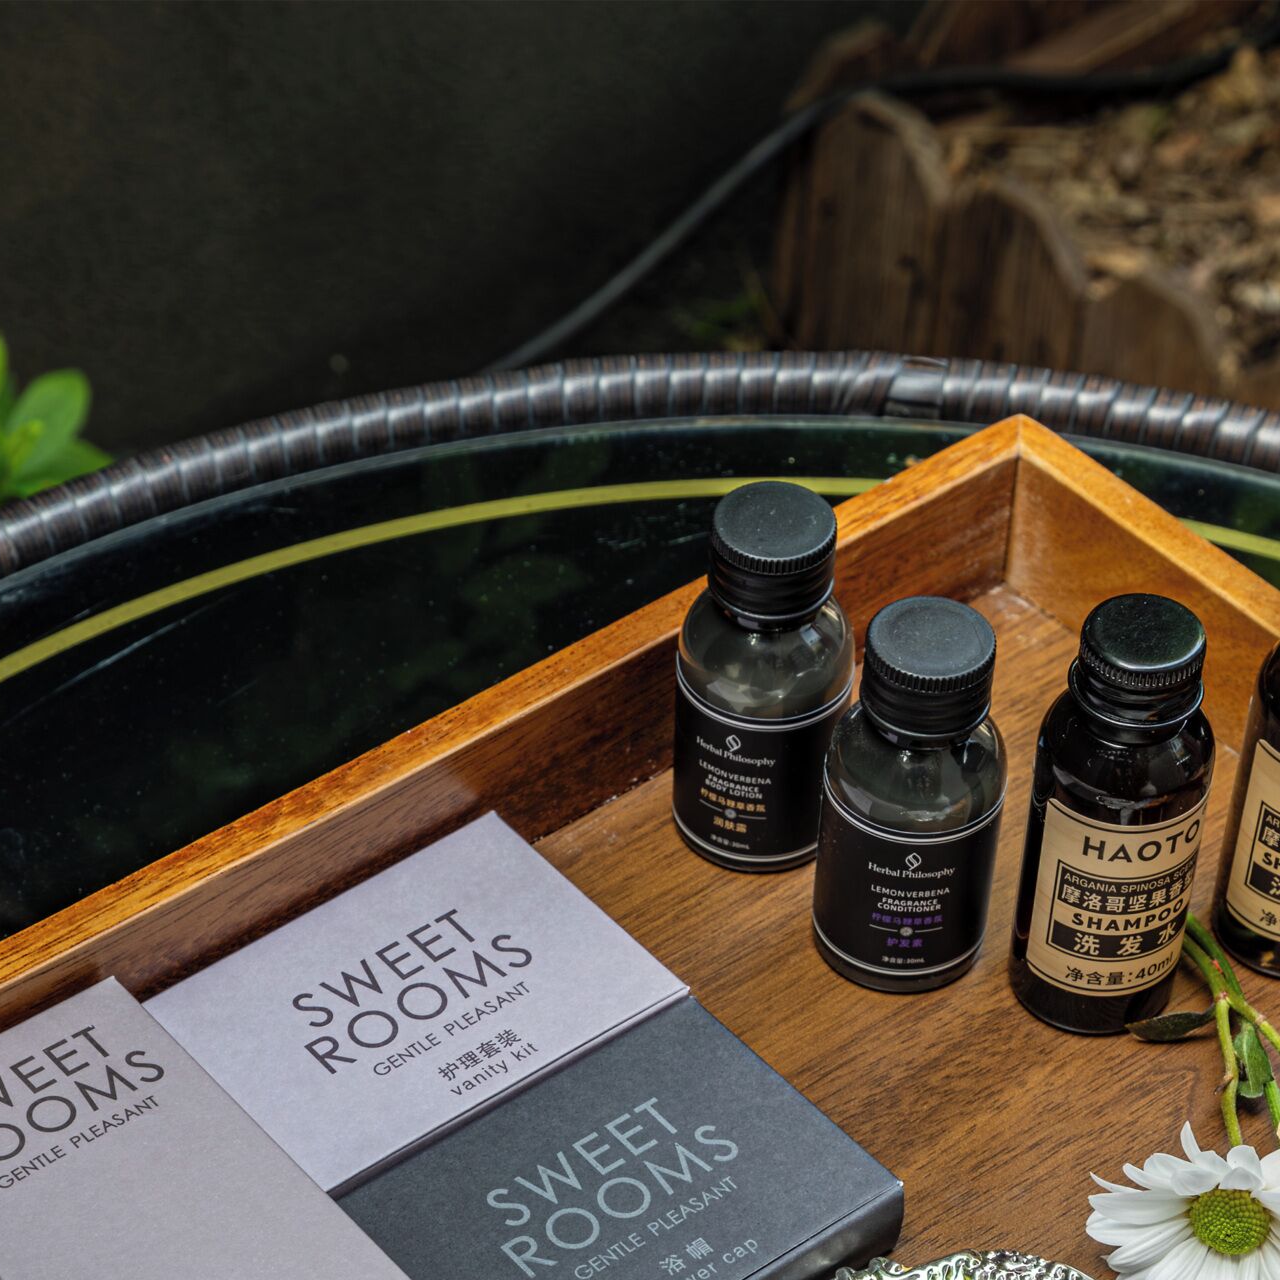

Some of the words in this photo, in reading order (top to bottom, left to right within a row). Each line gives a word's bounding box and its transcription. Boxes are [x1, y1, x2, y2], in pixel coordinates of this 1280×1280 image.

[696, 735, 723, 756] Herbal
[724, 750, 777, 768] Philosophy
[705, 778, 726, 792] BODY
[729, 787, 763, 799] LOTION
[708, 774, 760, 793] FRAGRANCE
[1082, 819, 1200, 863] HAOTO
[868, 861, 900, 877] Herbal
[902, 866, 956, 879] Philosophy
[1064, 872, 1117, 893] ARGANIA
[1120, 877, 1170, 894] SPINOSA
[877, 902, 942, 912] CONDITIONER
[881, 897, 938, 907] FRAGRANCE
[1071, 898, 1184, 932] SHAMPOO
[1073, 921, 1177, 957] 洗发水
[292, 909, 475, 1027] SWEET
[304, 934, 533, 1075] ROOMS
[373, 1033, 442, 1076] GENTLE
[443, 981, 530, 1036] PLEASANT
[438, 1028, 522, 1082] 护理套装
[450, 1058, 509, 1096] vanity
[511, 1042, 539, 1062] kit
[70, 1095, 159, 1149] PLEASANT
[486, 1097, 678, 1226] SWEET
[500, 1125, 739, 1279] ROOMS
[574, 1232, 646, 1280] GENTLE
[647, 1176, 738, 1236] PLEASANT
[659, 1237, 714, 1276] 浴帽
[722, 1238, 759, 1264] cap
